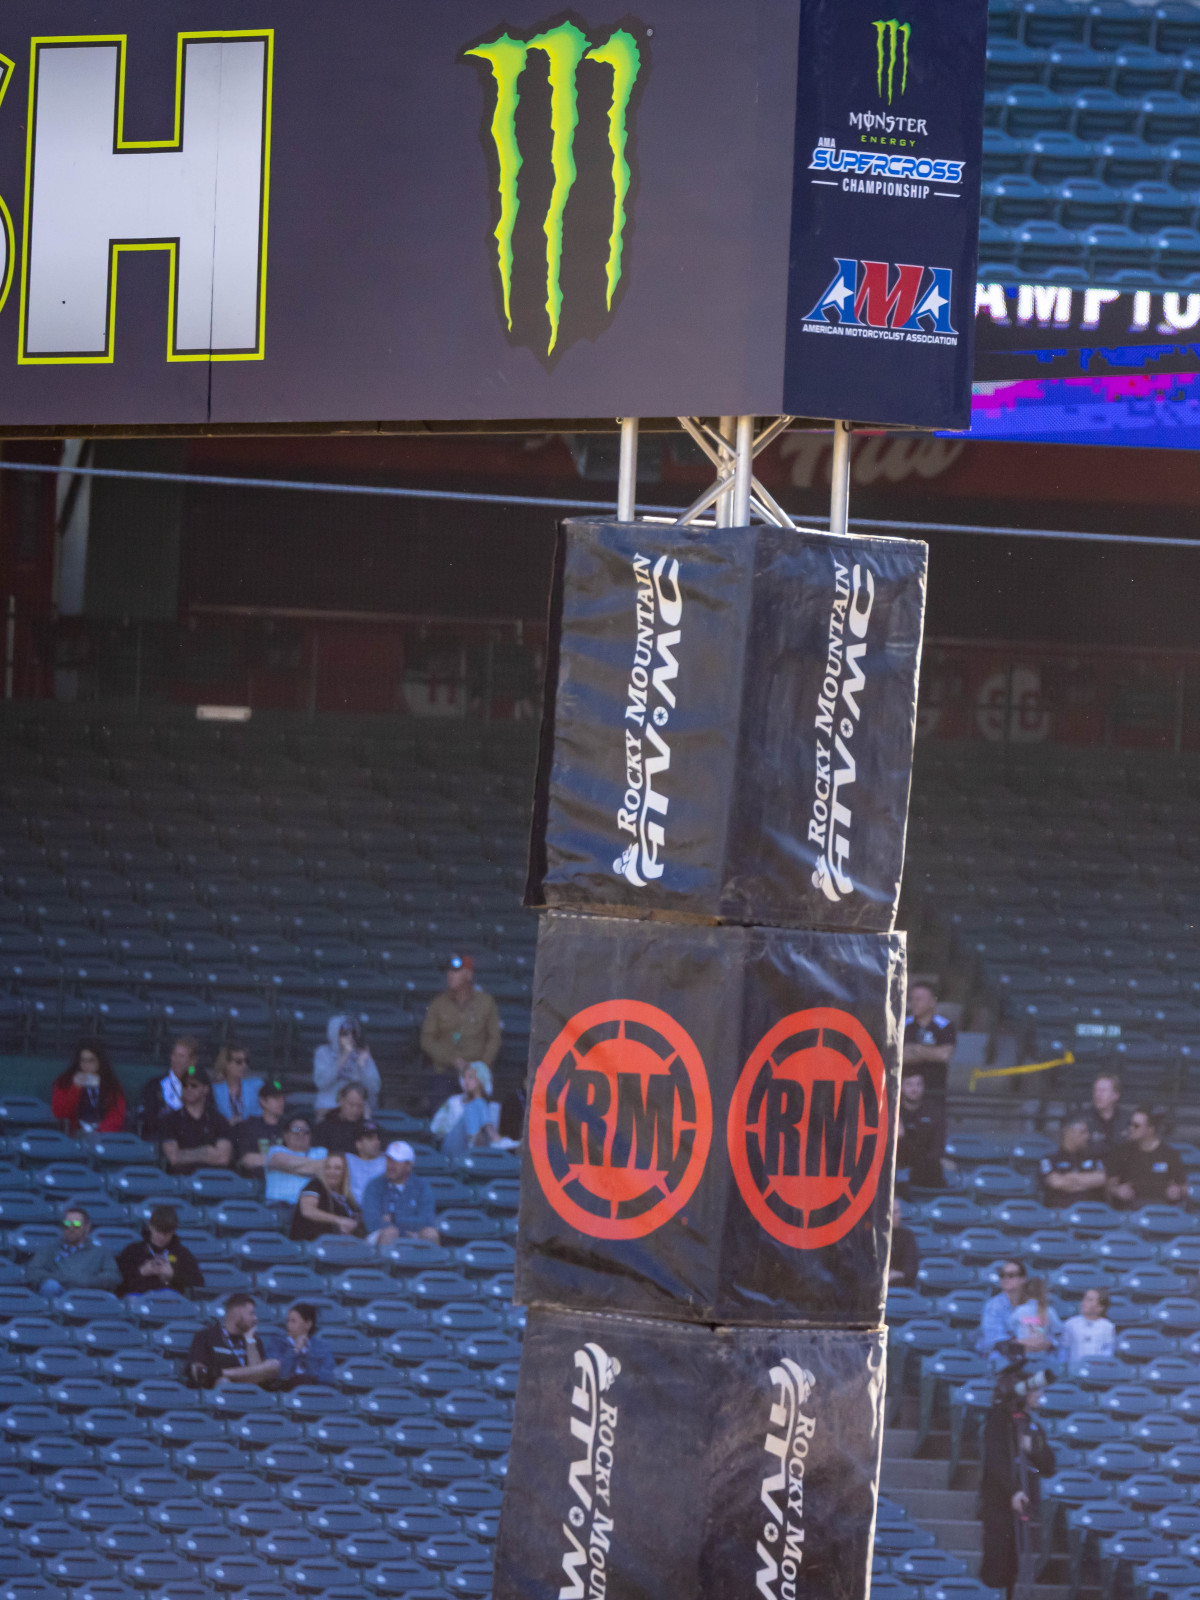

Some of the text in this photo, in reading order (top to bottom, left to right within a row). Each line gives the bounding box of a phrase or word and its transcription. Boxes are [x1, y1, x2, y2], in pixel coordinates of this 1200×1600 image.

[818, 137, 836, 148] AMA
[849, 110, 928, 136] MONSTER
[860, 135, 916, 147] ENERGY
[808, 147, 967, 184] SUPERCROSS
[842, 178, 930, 199] CHAMPIONSHIP
[801, 257, 959, 335] AMA
[802, 323, 958, 346] AMERICAN MOTORCYCLIST ASSOCIATION
[617, 552, 656, 837] ROCKY MOUNTAIN
[808, 560, 850, 850] ROCKY MOUNTAIN
[562, 1069, 682, 1171] RM
[764, 1077, 866, 1178] RM
[595, 1397, 618, 1507] ROCKY
[787, 1410, 817, 1518] ROCKY
